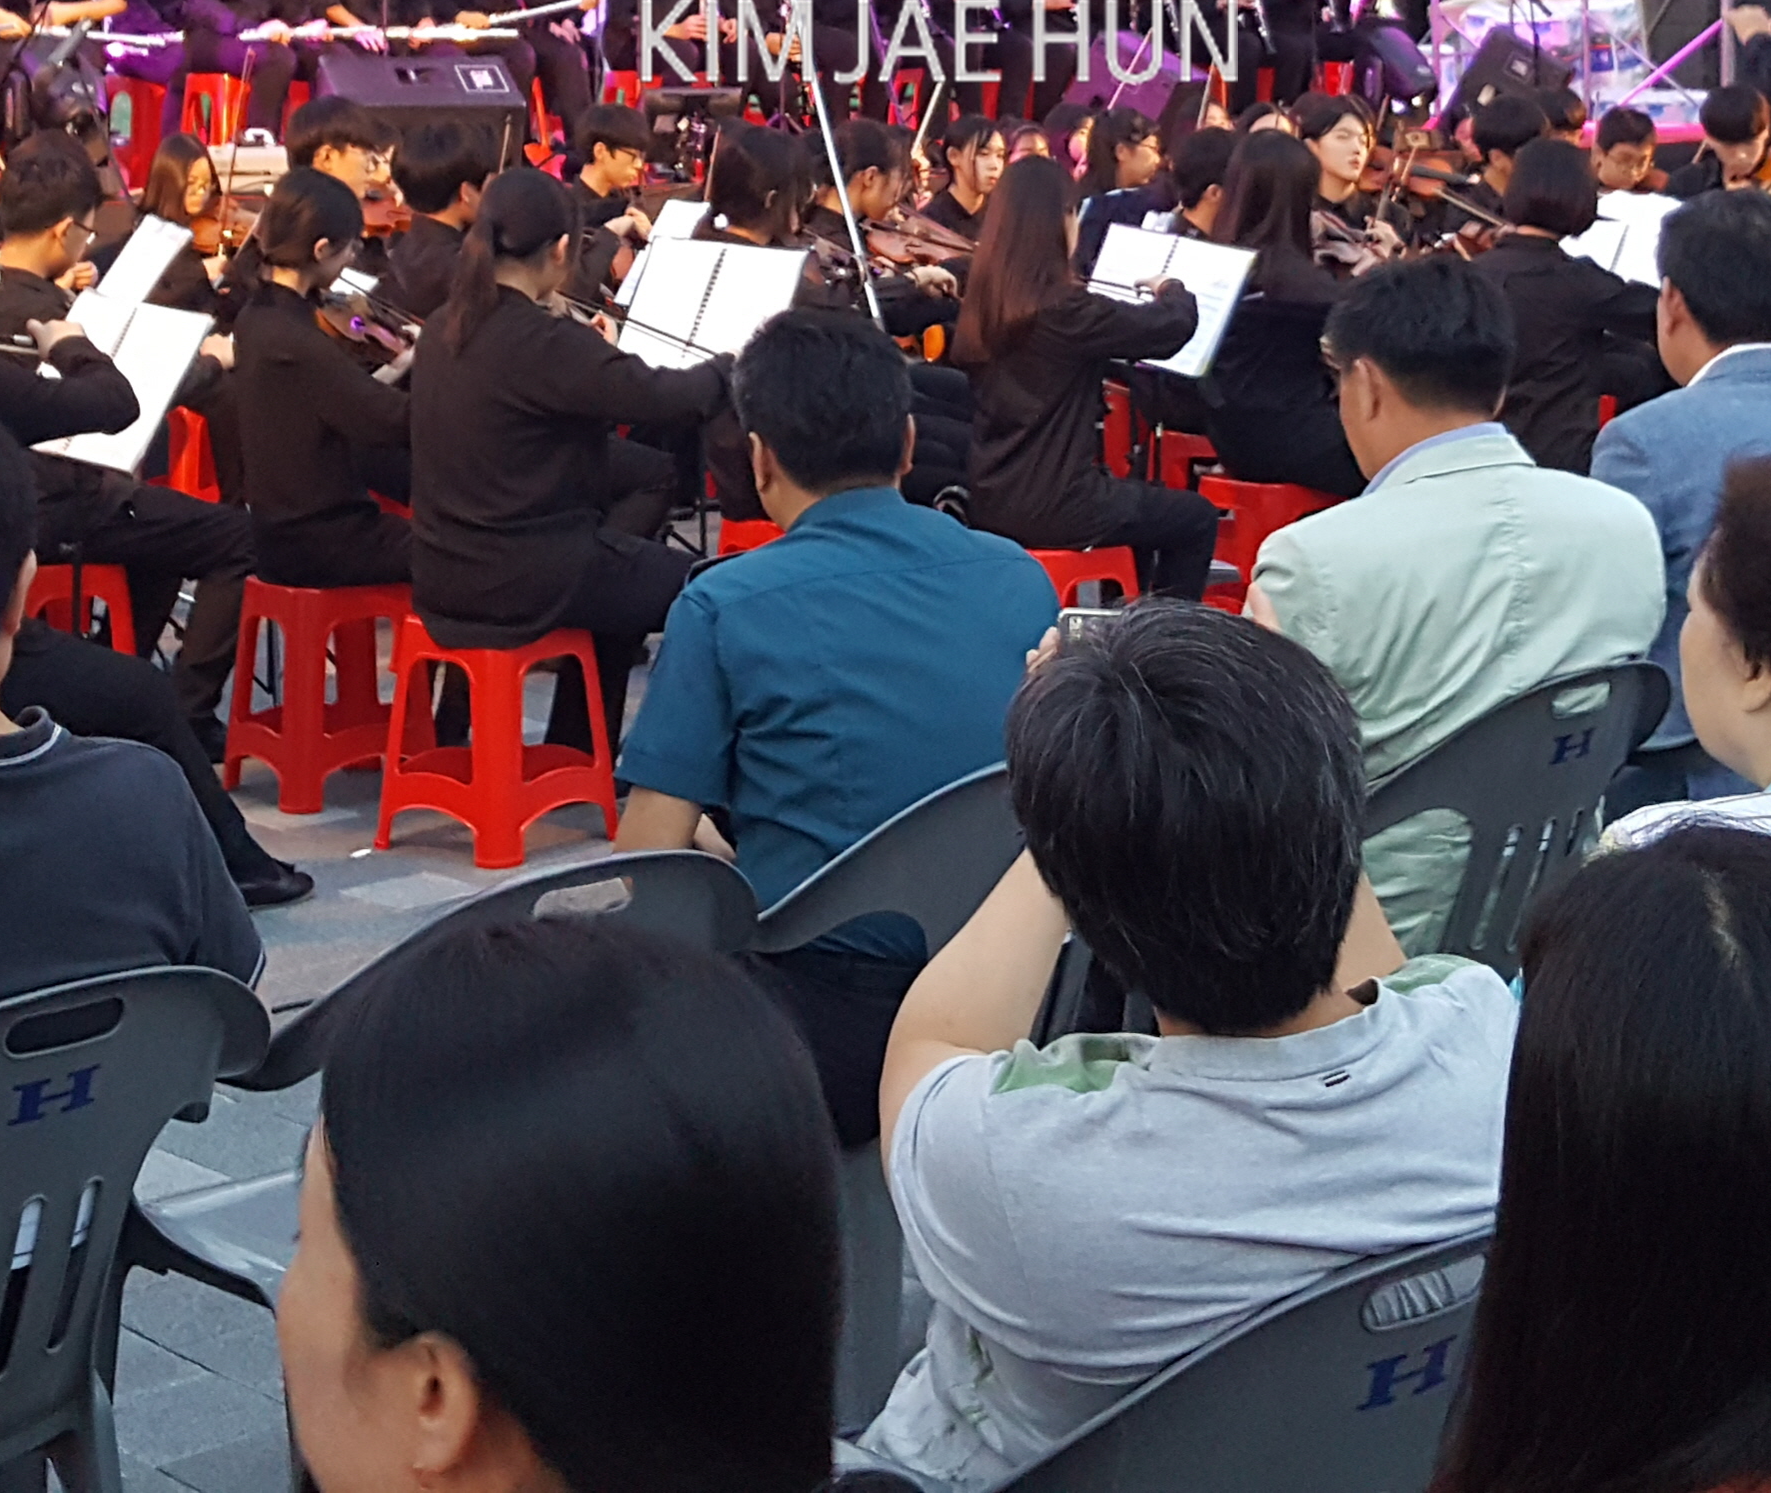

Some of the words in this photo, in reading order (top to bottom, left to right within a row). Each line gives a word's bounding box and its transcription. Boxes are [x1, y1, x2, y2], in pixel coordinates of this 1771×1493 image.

[1549, 727, 1597, 766] H
[6, 1062, 101, 1126] H
[1355, 1334, 1458, 1413] H
